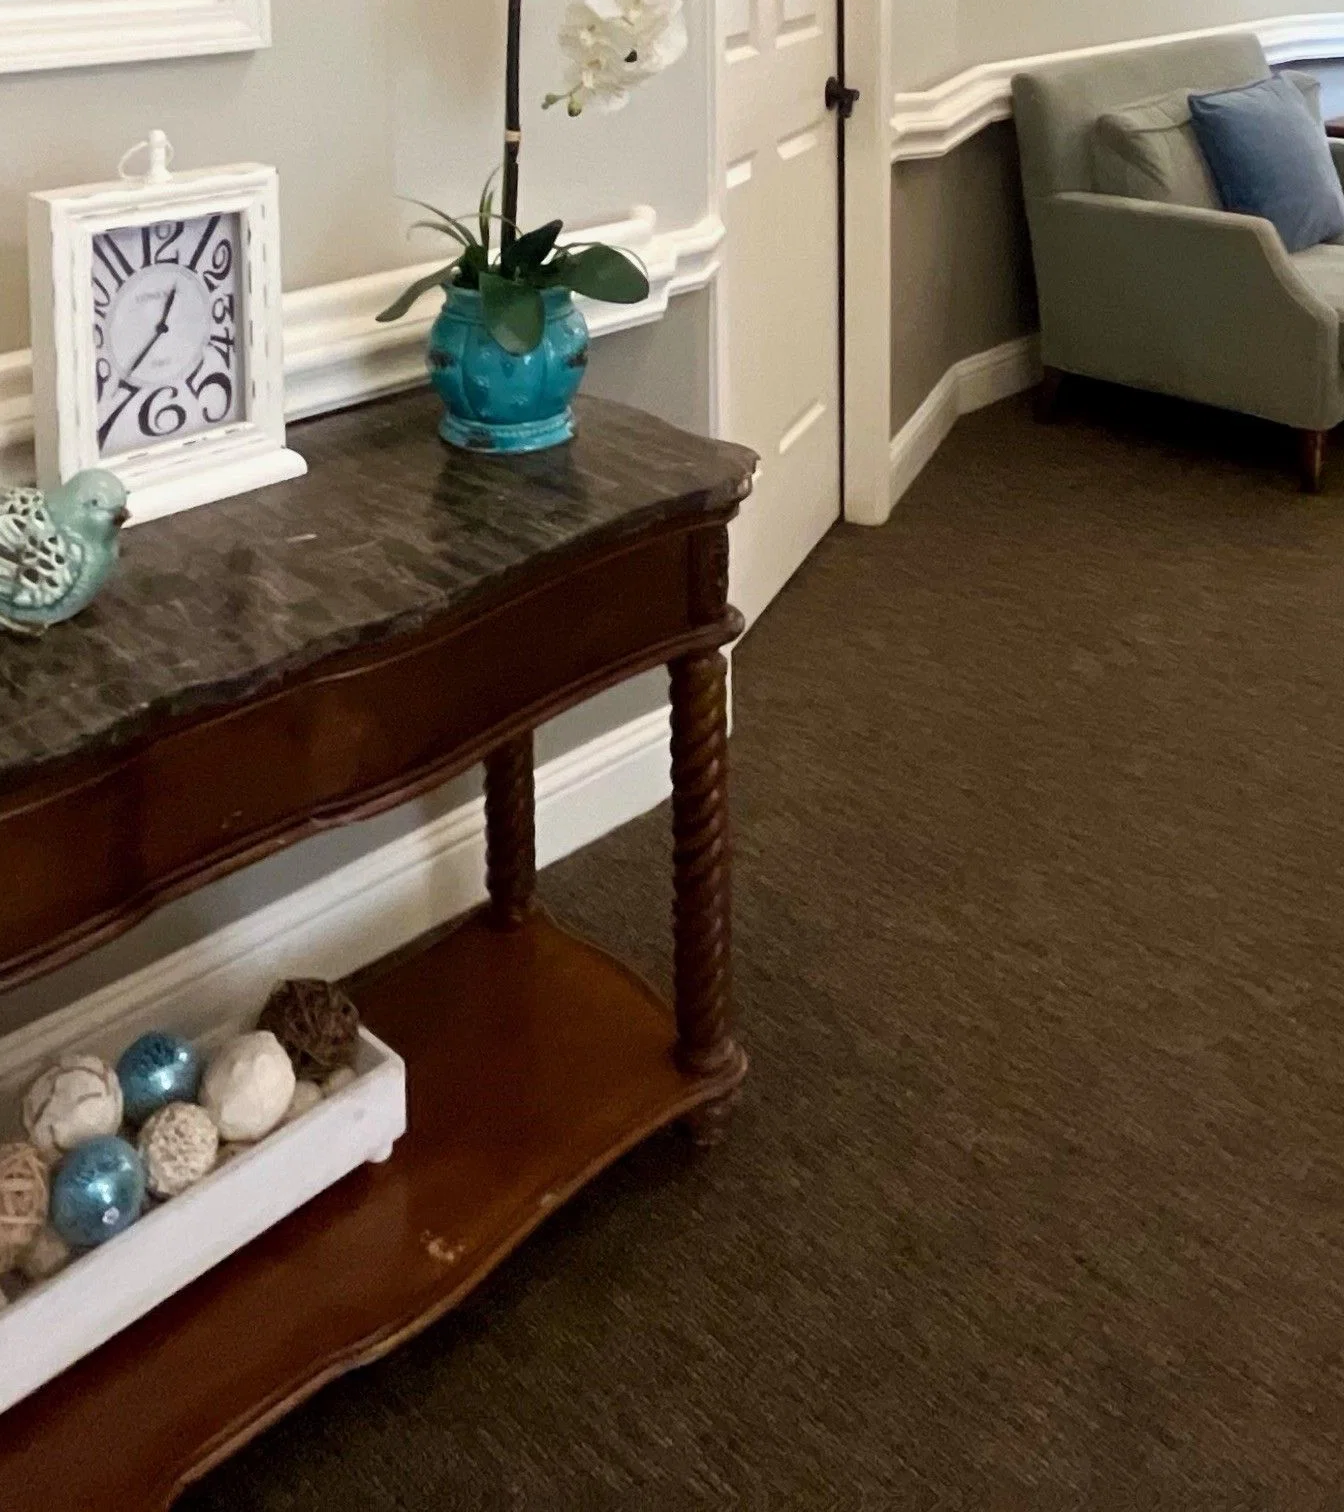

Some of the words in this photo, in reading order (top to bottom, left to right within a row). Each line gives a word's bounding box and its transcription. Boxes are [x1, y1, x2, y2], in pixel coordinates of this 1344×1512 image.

[141, 222, 184, 269] 12
[203, 239, 233, 293] 2
[97, 379, 142, 452] 7
[138, 386, 186, 436] 6
[185, 359, 233, 423] 5
